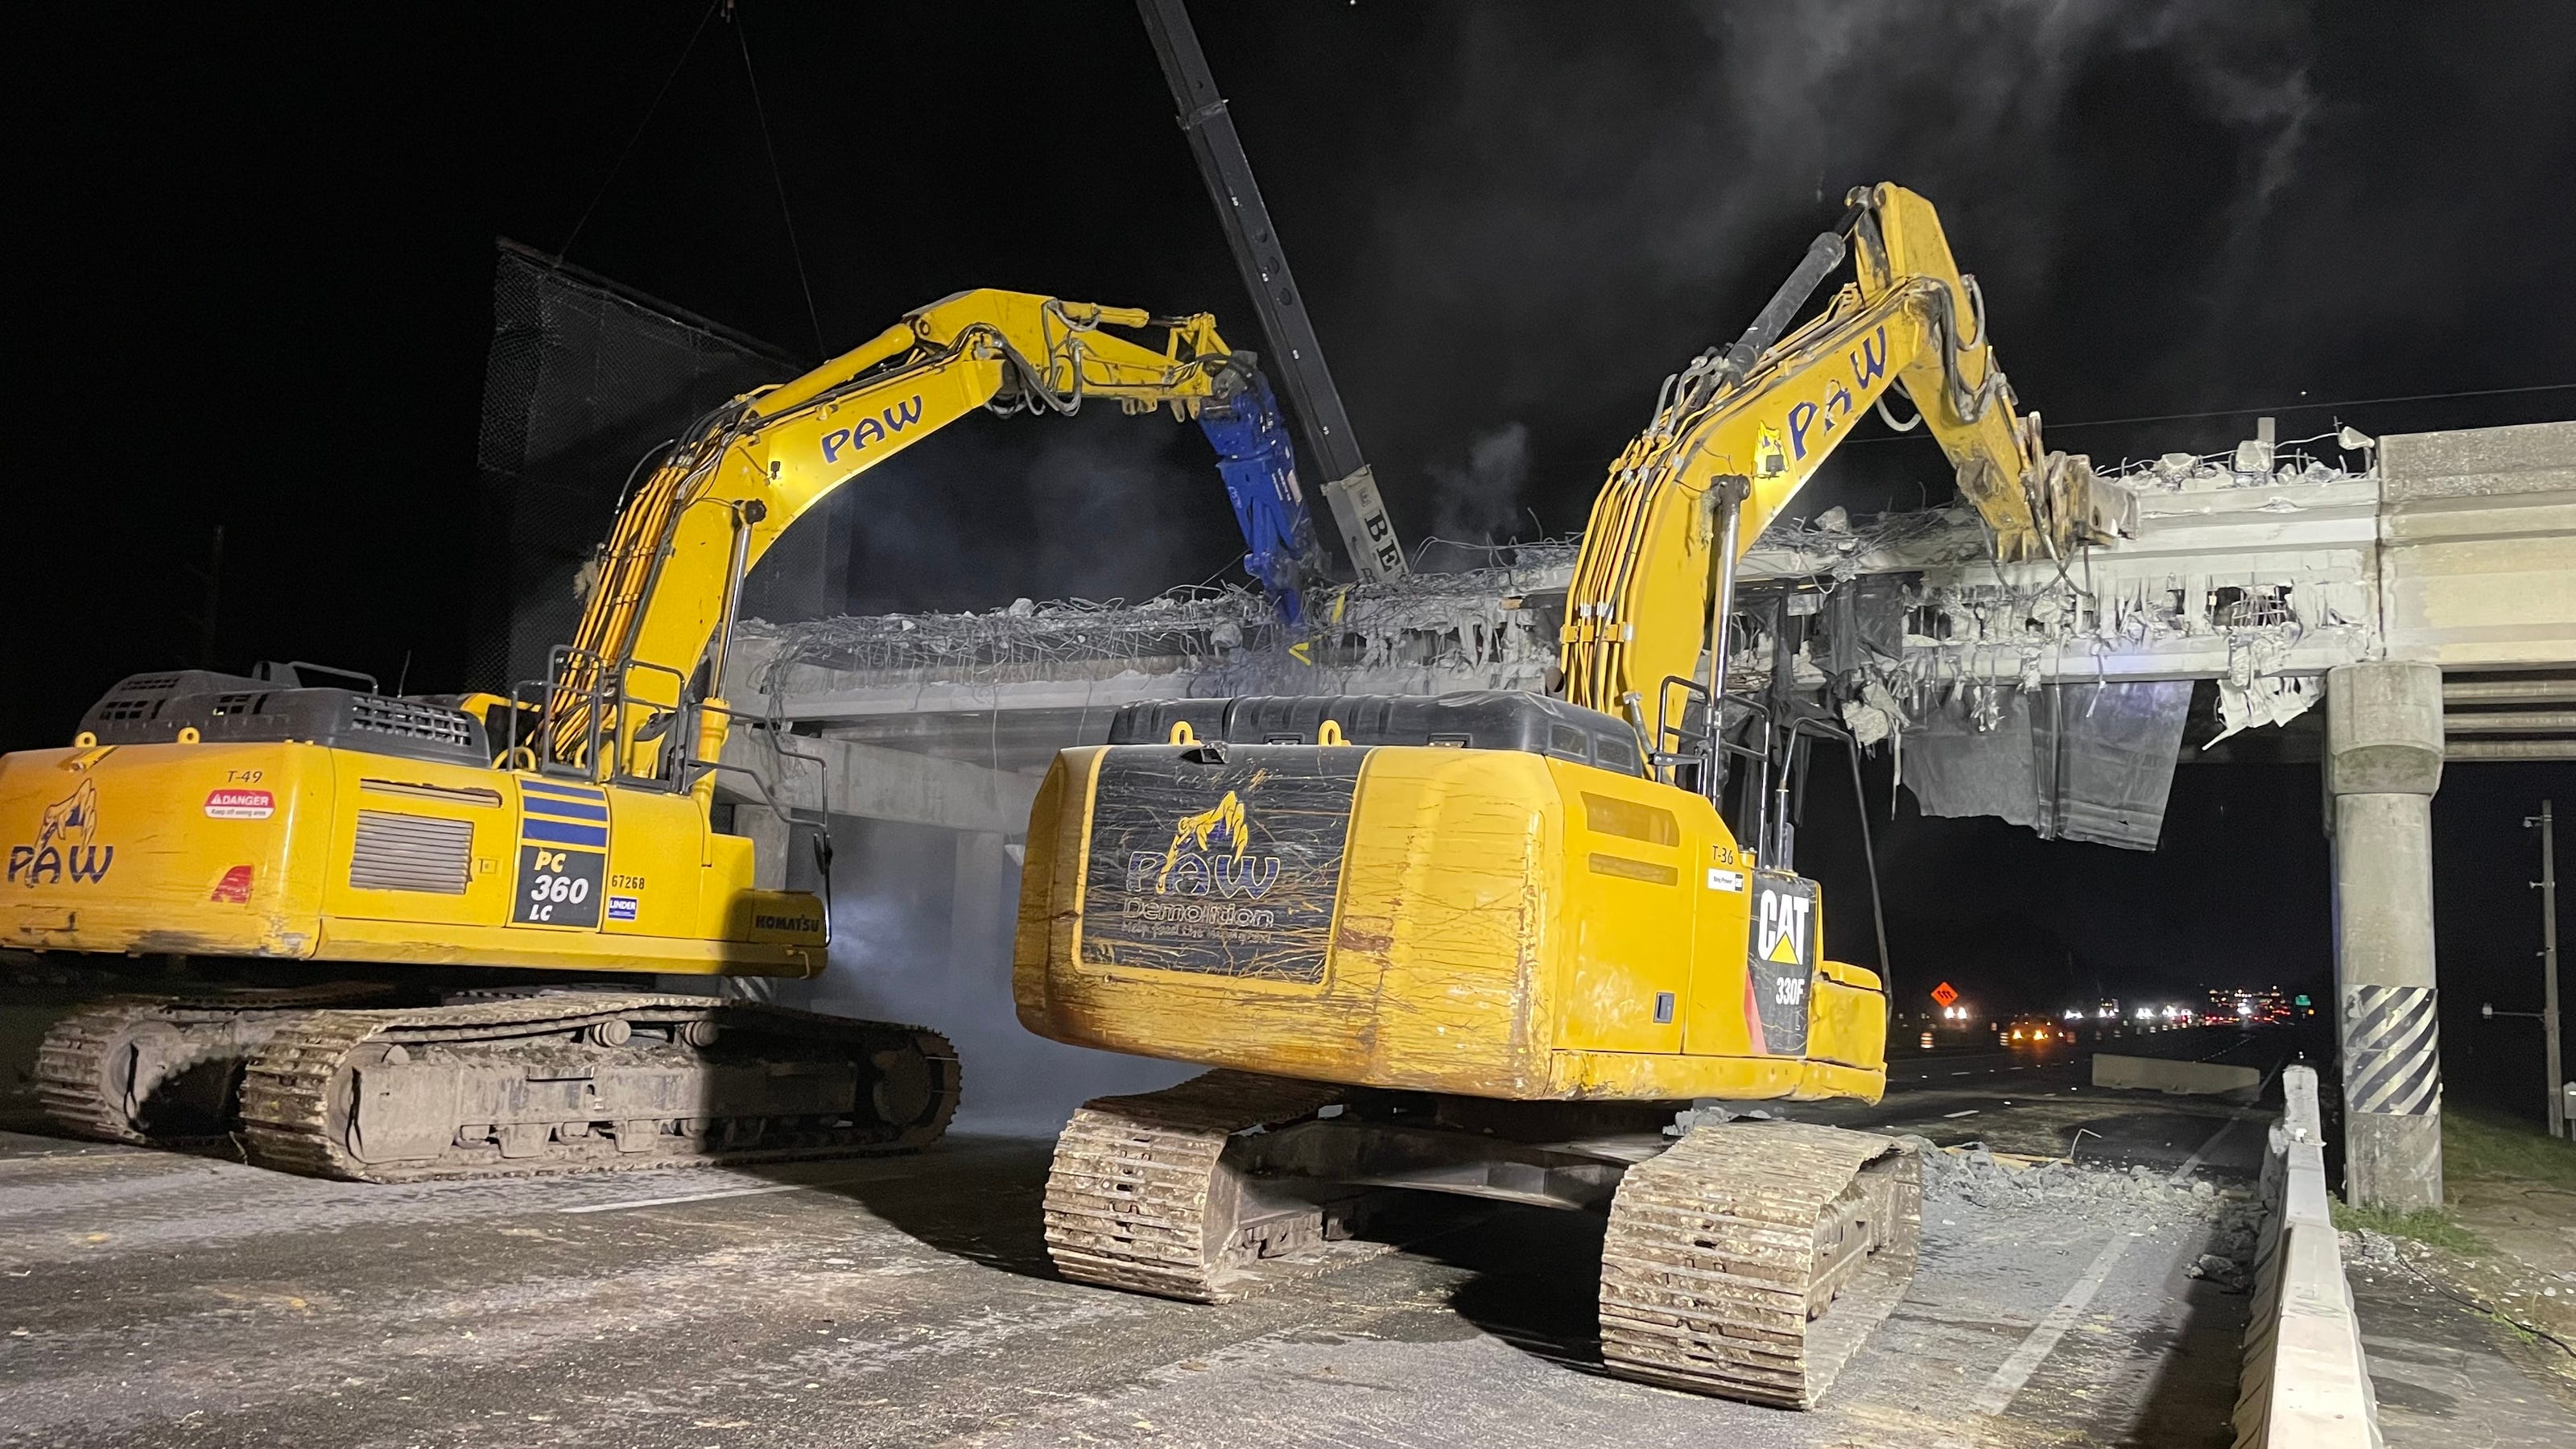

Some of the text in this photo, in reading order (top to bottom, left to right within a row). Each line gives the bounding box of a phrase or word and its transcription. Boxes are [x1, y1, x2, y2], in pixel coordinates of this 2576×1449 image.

[1788, 324, 1886, 461] PAW
[820, 394, 923, 464] PAW
[228, 770, 262, 784] T-49
[222, 794, 270, 806] DANGER
[7, 845, 114, 885] PAW
[534, 850, 567, 873] PC
[1712, 844, 1734, 865] T-36
[612, 874, 645, 890] 67268
[1126, 850, 1281, 901] PAW
[530, 874, 589, 904] 360
[528, 903, 554, 922] LC
[609, 900, 636, 910] LINDER
[1121, 897, 1274, 927] Demolition
[755, 914, 820, 932] KOMATSU
[1757, 889, 1810, 965] CAT
[1775, 976, 1806, 1005] 330F
